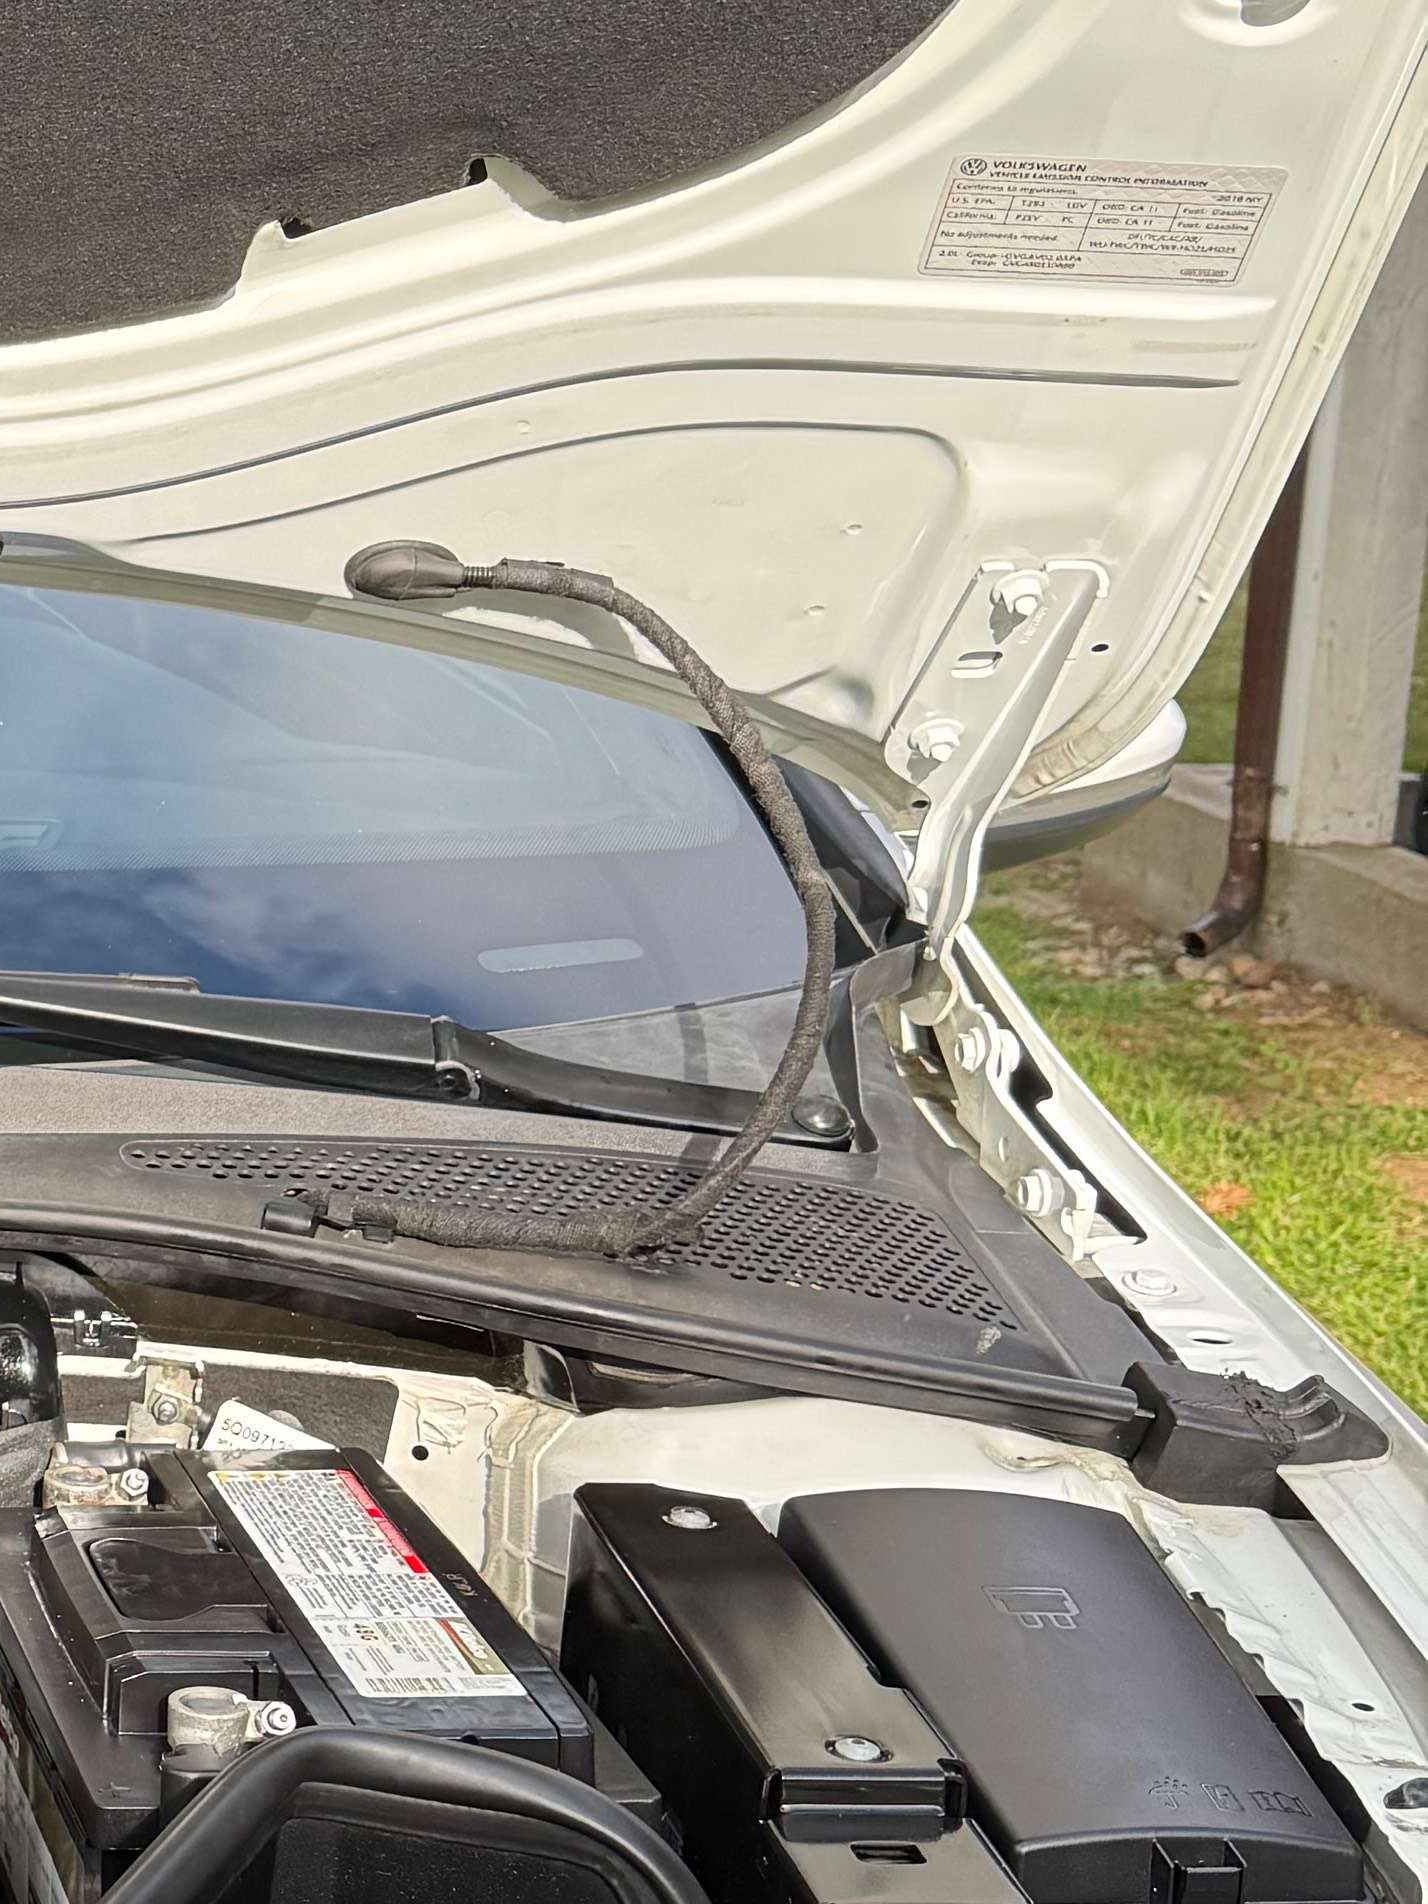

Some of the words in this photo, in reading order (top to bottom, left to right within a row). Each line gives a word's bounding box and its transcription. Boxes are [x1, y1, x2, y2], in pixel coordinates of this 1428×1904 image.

[994, 161, 1087, 172] VOLKSWAGEN
[990, 171, 1029, 179] VEHICLE
[1032, 173, 1081, 181] EMISSION
[1134, 178, 1208, 187] INFORMATION
